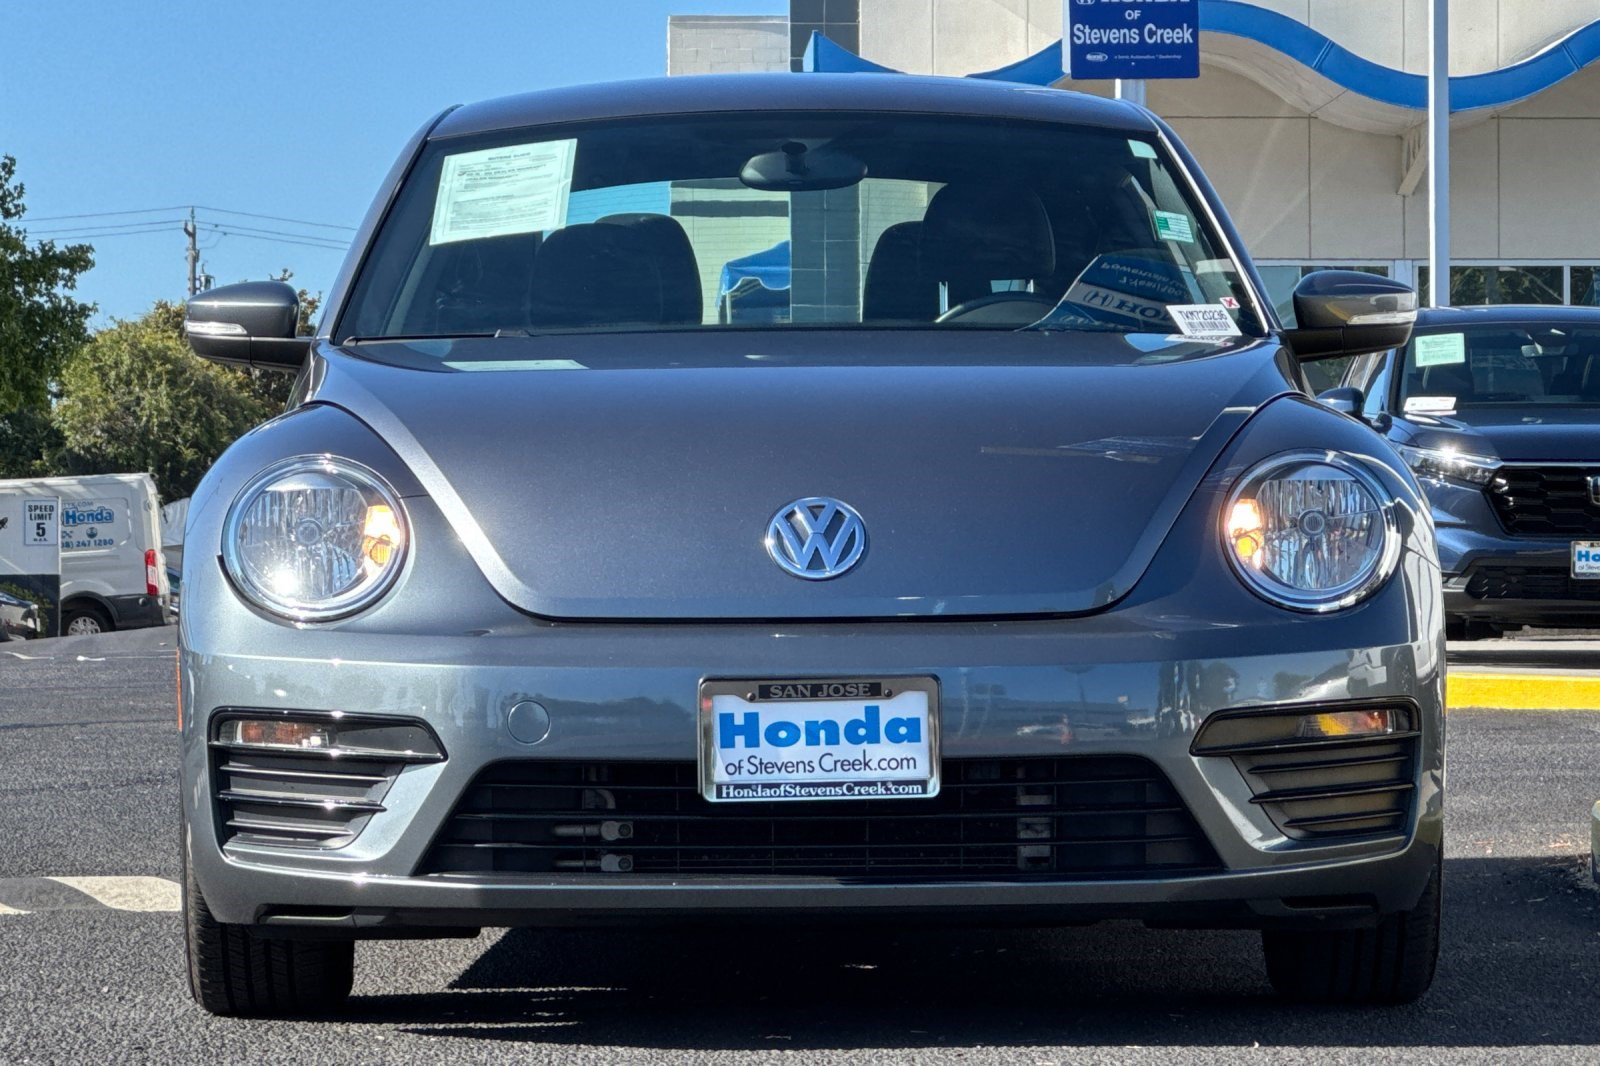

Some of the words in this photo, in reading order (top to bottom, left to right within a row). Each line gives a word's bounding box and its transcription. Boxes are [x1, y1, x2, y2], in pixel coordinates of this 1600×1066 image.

[1125, 10, 1141, 20] OF
[1073, 23, 1140, 44] Stevens
[1144, 23, 1193, 44] Creek
[28, 504, 55, 512] SPEED
[30, 513, 52, 521] LIMIT
[64, 509, 113, 525] Honda
[36, 522, 46, 537] 5
[769, 683, 812, 698] SAN
[817, 682, 871, 698] JOSE
[719, 705, 922, 749] Honda
[725, 758, 744, 775] of
[747, 755, 815, 775] Stevens
[819, 749, 917, 773] Creek.com
[721, 782, 923, 798] HondaofStevensCreek.com
